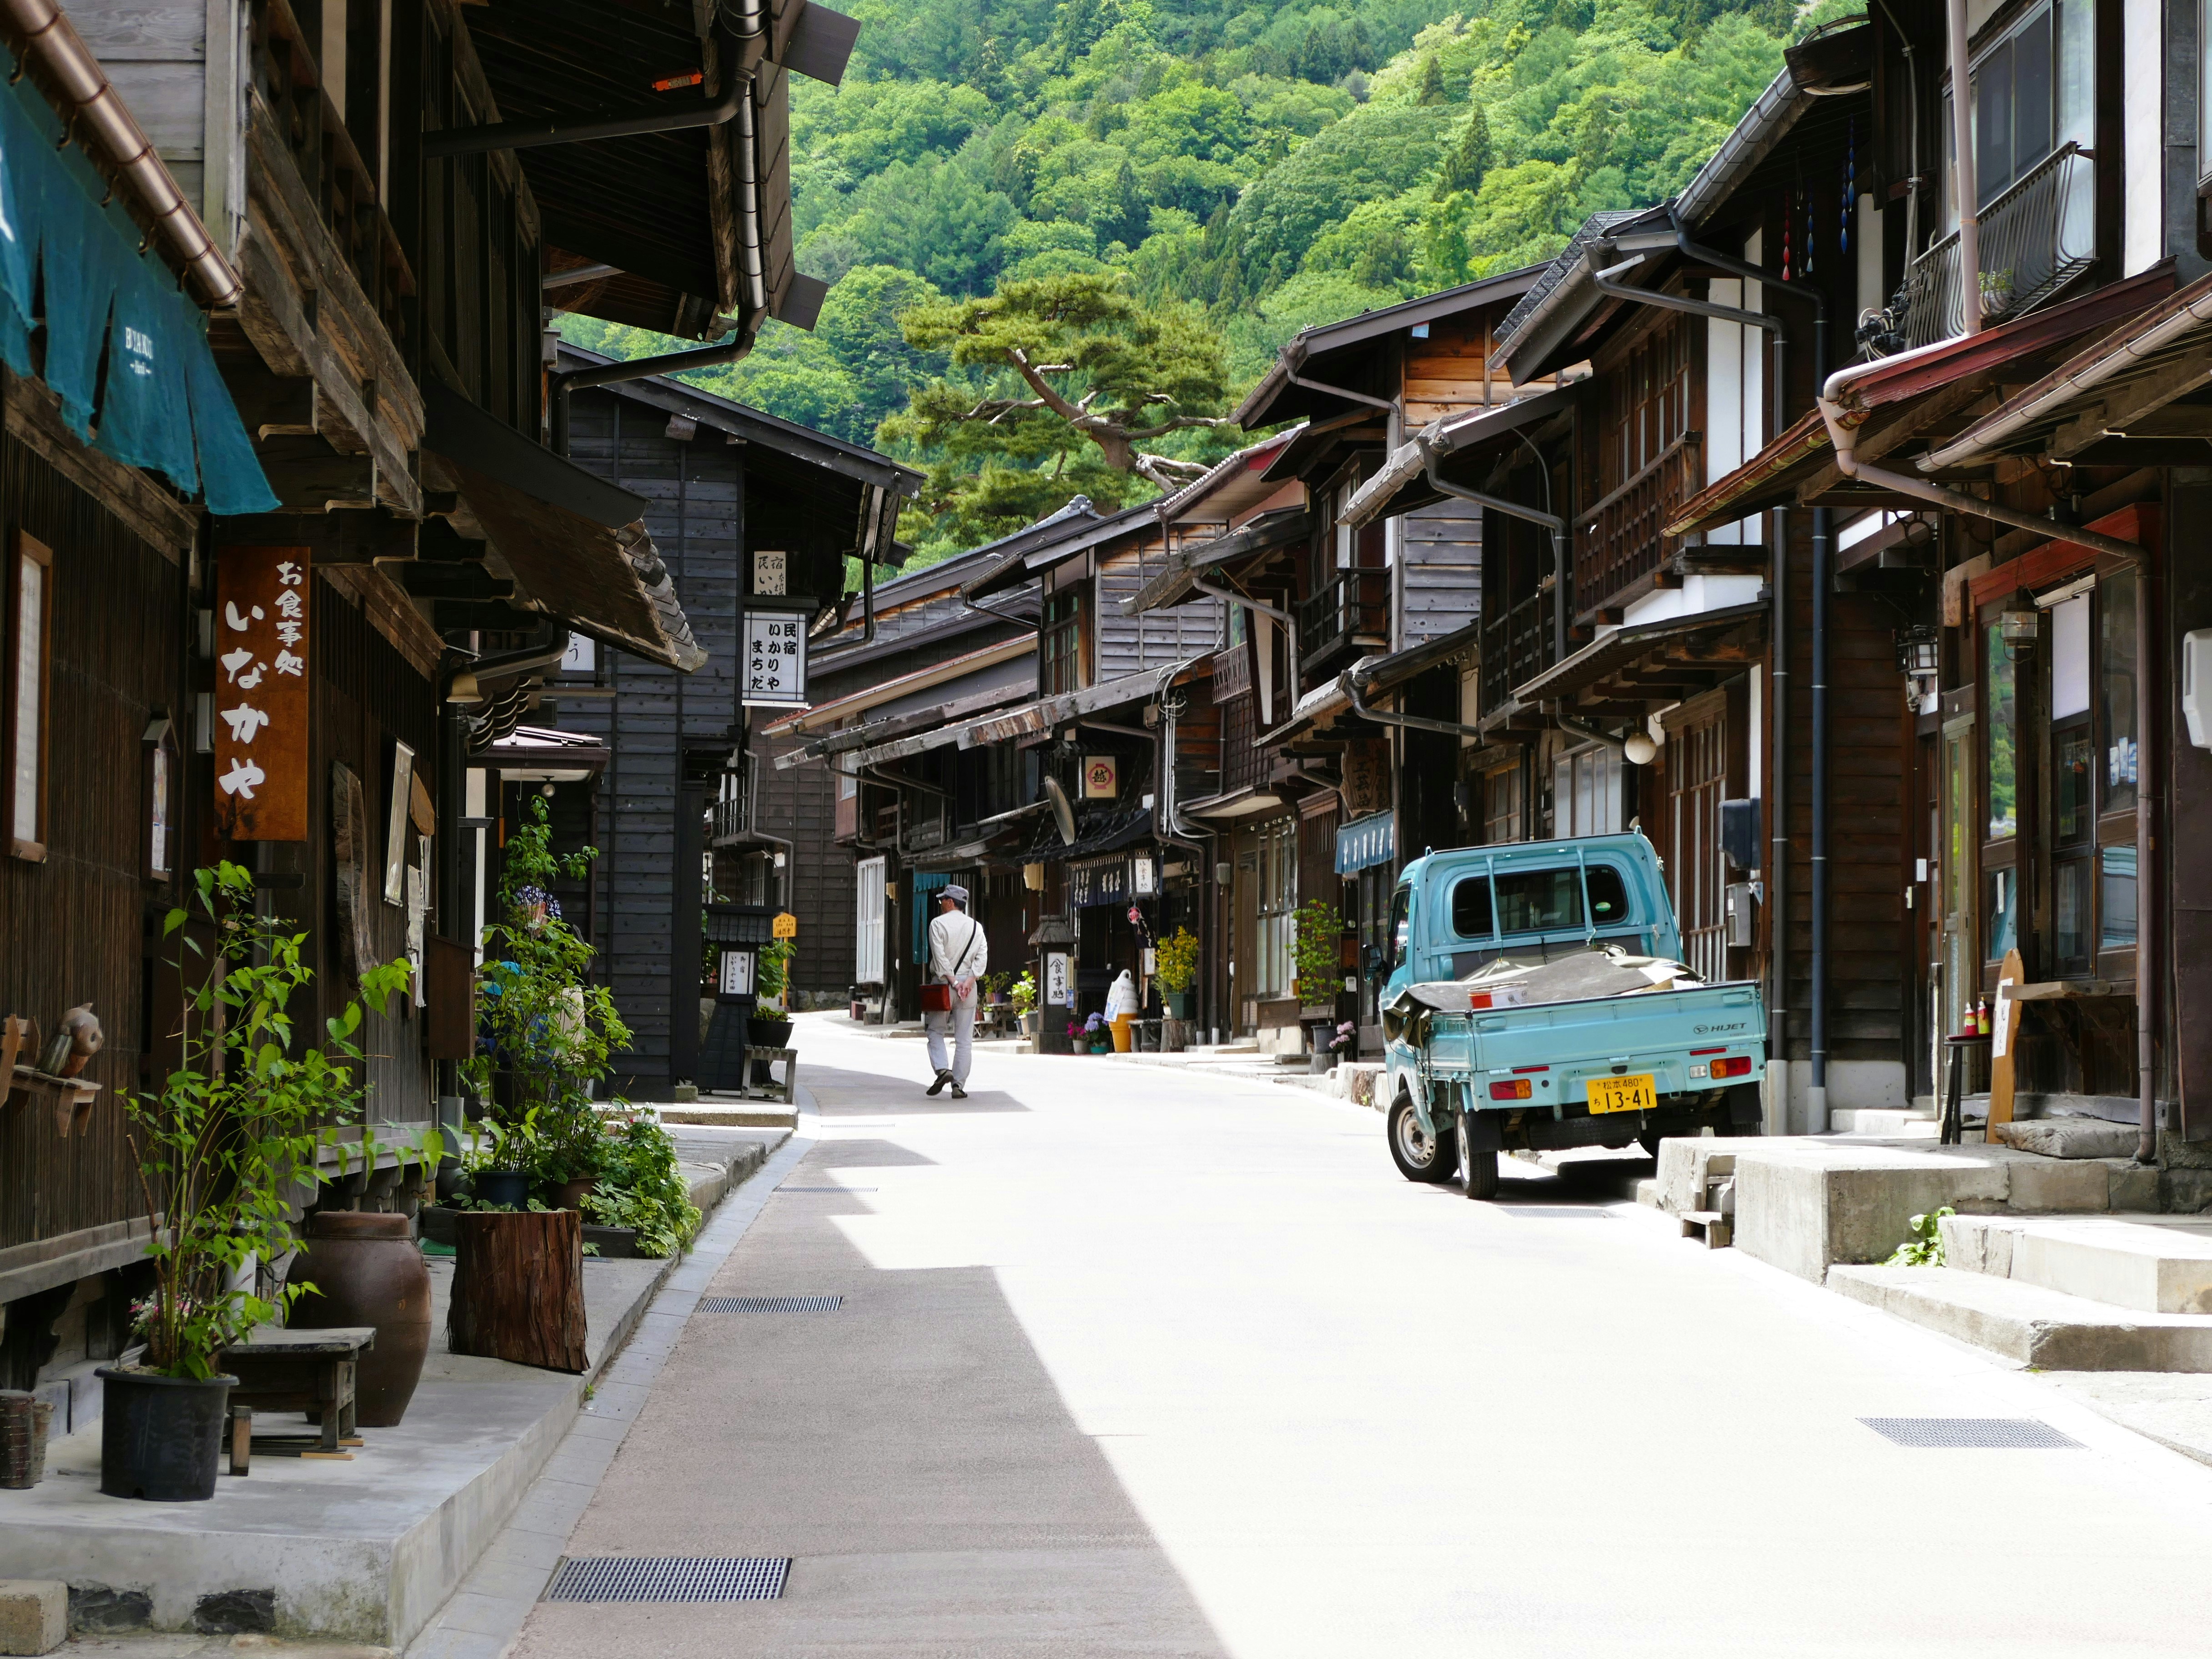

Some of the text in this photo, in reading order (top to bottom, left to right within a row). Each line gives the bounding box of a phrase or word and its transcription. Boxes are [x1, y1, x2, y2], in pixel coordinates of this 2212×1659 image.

[125, 327, 154, 360] BYAKU
[758, 555, 784, 569] 民宿
[274, 560, 304, 677] お食事処
[783, 623, 797, 655] 民宿
[751, 640, 764, 690] まちだ
[767, 623, 781, 690] いかりや
[218, 599, 269, 799] いなかや
[1092, 769, 1107, 782] 越
[1050, 958, 1064, 999] 食事処
[1711, 1022, 1747, 1032] HIJET
[1594, 1088, 1650, 1109] ち 13-41
[1603, 1078, 1639, 1090] 松本 480
